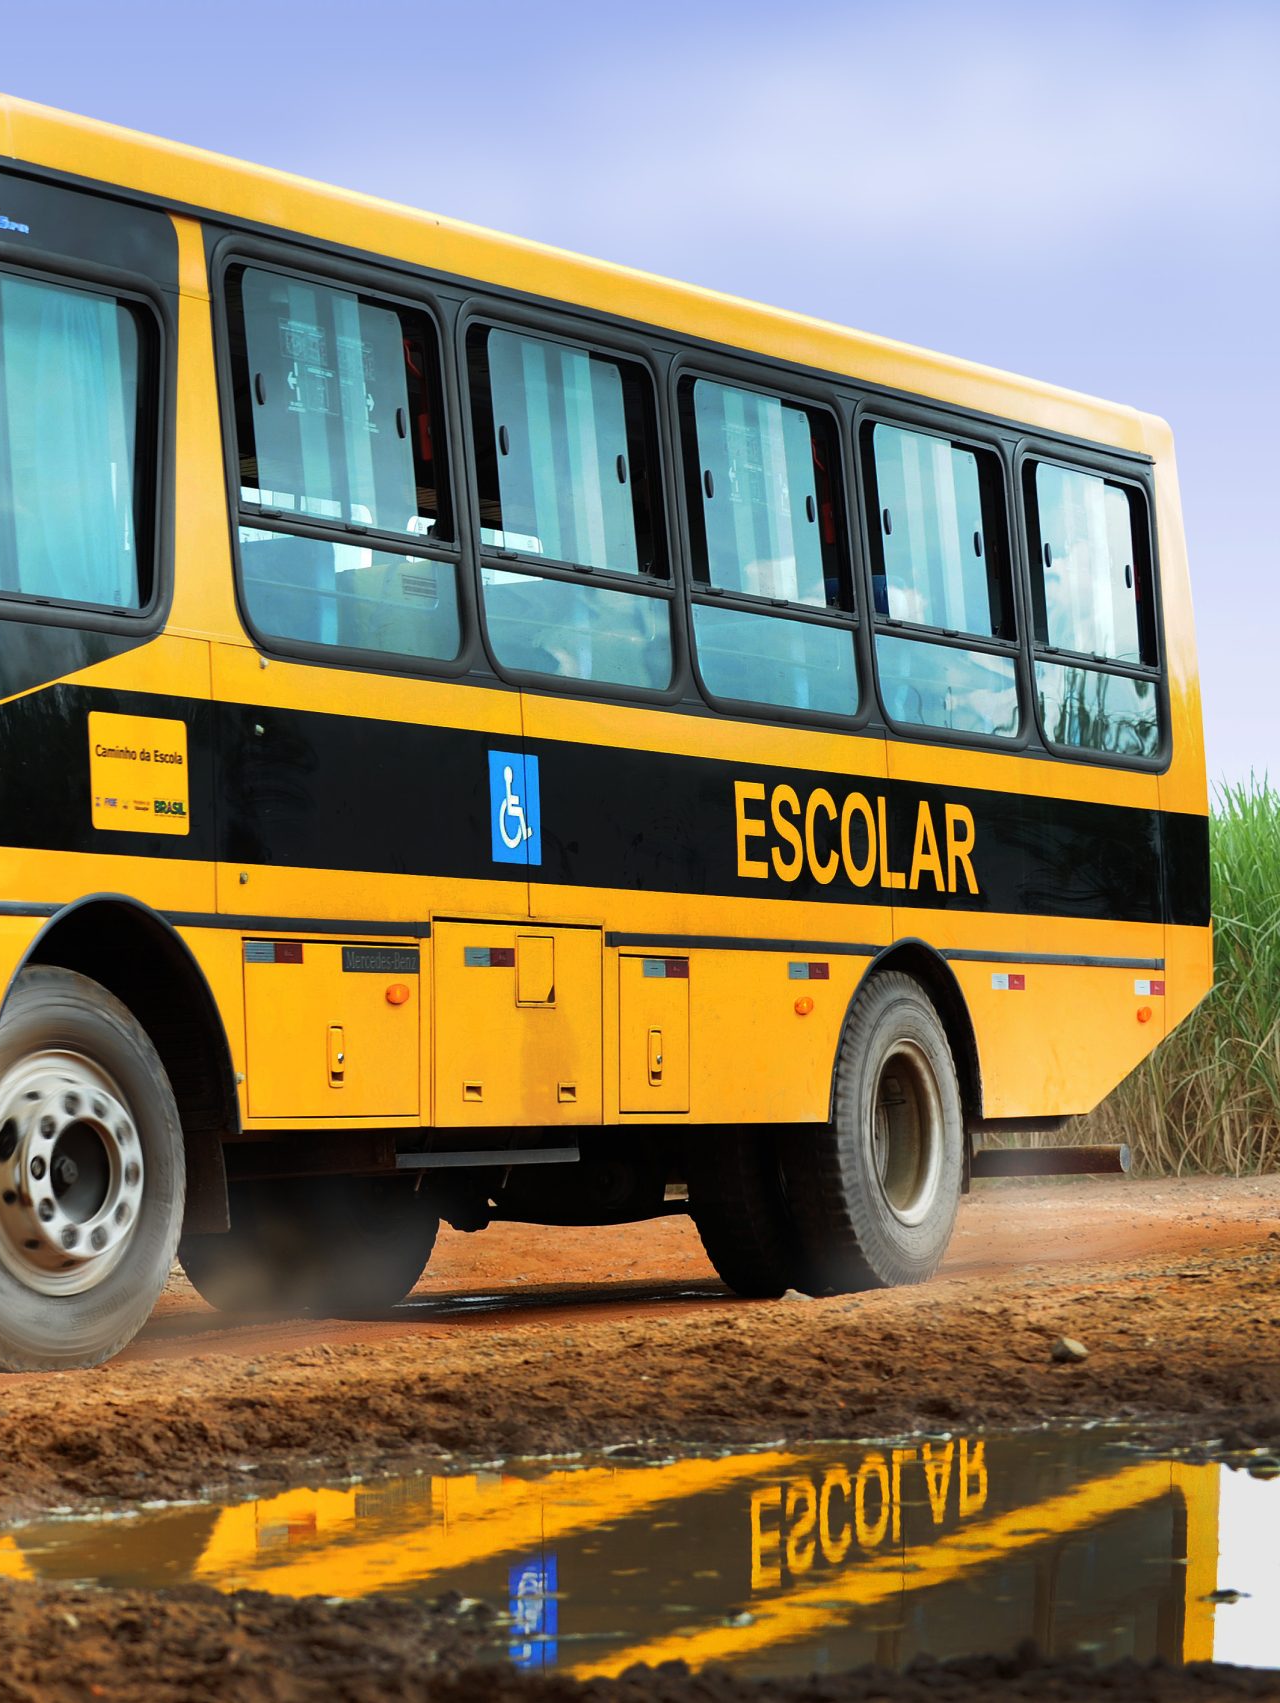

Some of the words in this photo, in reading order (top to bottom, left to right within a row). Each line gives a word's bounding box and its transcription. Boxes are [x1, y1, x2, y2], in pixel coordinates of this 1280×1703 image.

[95, 744, 137, 760] Caminho
[139, 748, 151, 762] da
[153, 750, 183, 765] Escola
[153, 800, 187, 815] BRASIL
[733, 780, 980, 895] ESCOLAR
[345, 951, 417, 970] Mercedes-Benz
